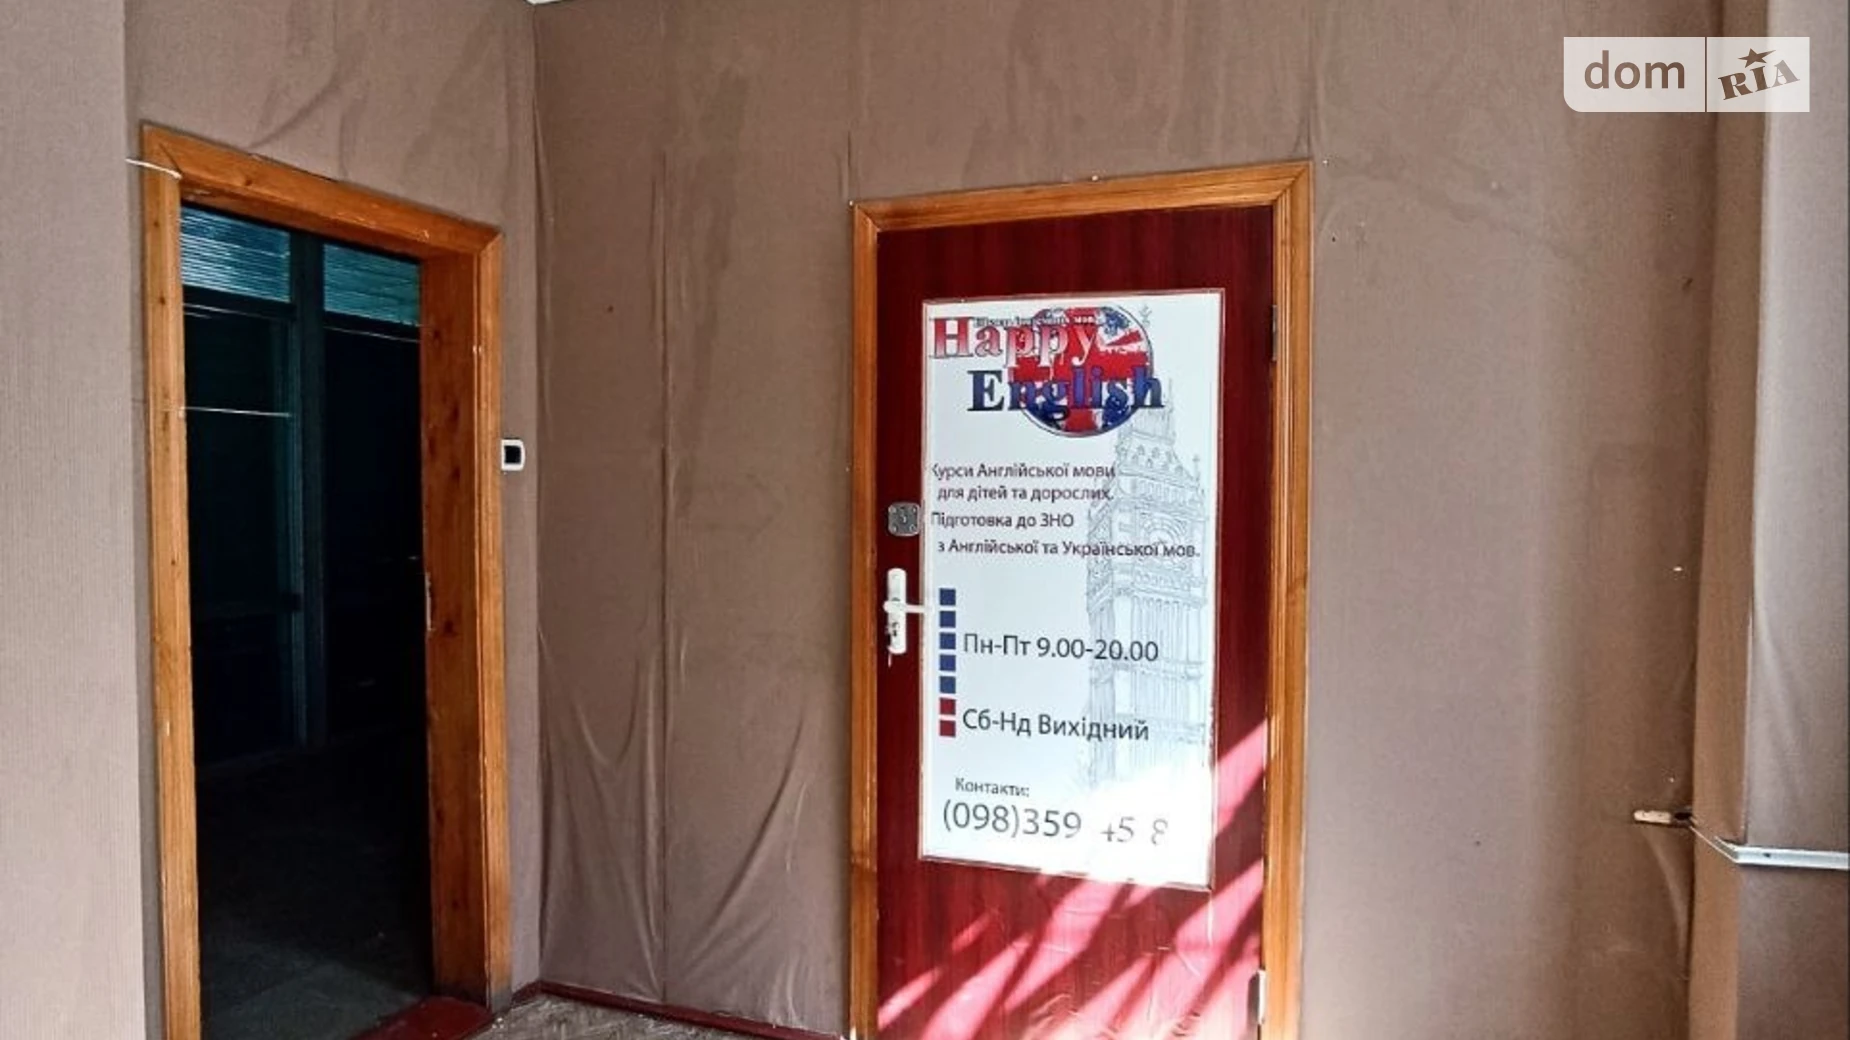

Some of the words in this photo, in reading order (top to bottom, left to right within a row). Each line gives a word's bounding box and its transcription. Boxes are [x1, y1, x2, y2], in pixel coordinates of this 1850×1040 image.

[929, 315, 1099, 369] Happy
[967, 366, 1164, 423] English
[977, 462, 1070, 479] Англійської
[1073, 464, 1115, 478] мови
[938, 488, 965, 501] для
[967, 485, 1008, 502] дітей
[1011, 488, 1029, 500] та
[931, 512, 1013, 529] Підготовка
[1016, 515, 1037, 529] до
[938, 541, 945, 552] з
[948, 538, 1039, 556] Англійської
[1042, 542, 1059, 555] та
[1062, 542, 1159, 559] Української
[963, 633, 1031, 656] Пн-Пт
[1036, 637, 1159, 661] 9.00-20.00
[962, 708, 1032, 736] Сб-Нд
[1038, 714, 1149, 742] Вихідний
[943, 798, 1082, 839] (098)359
